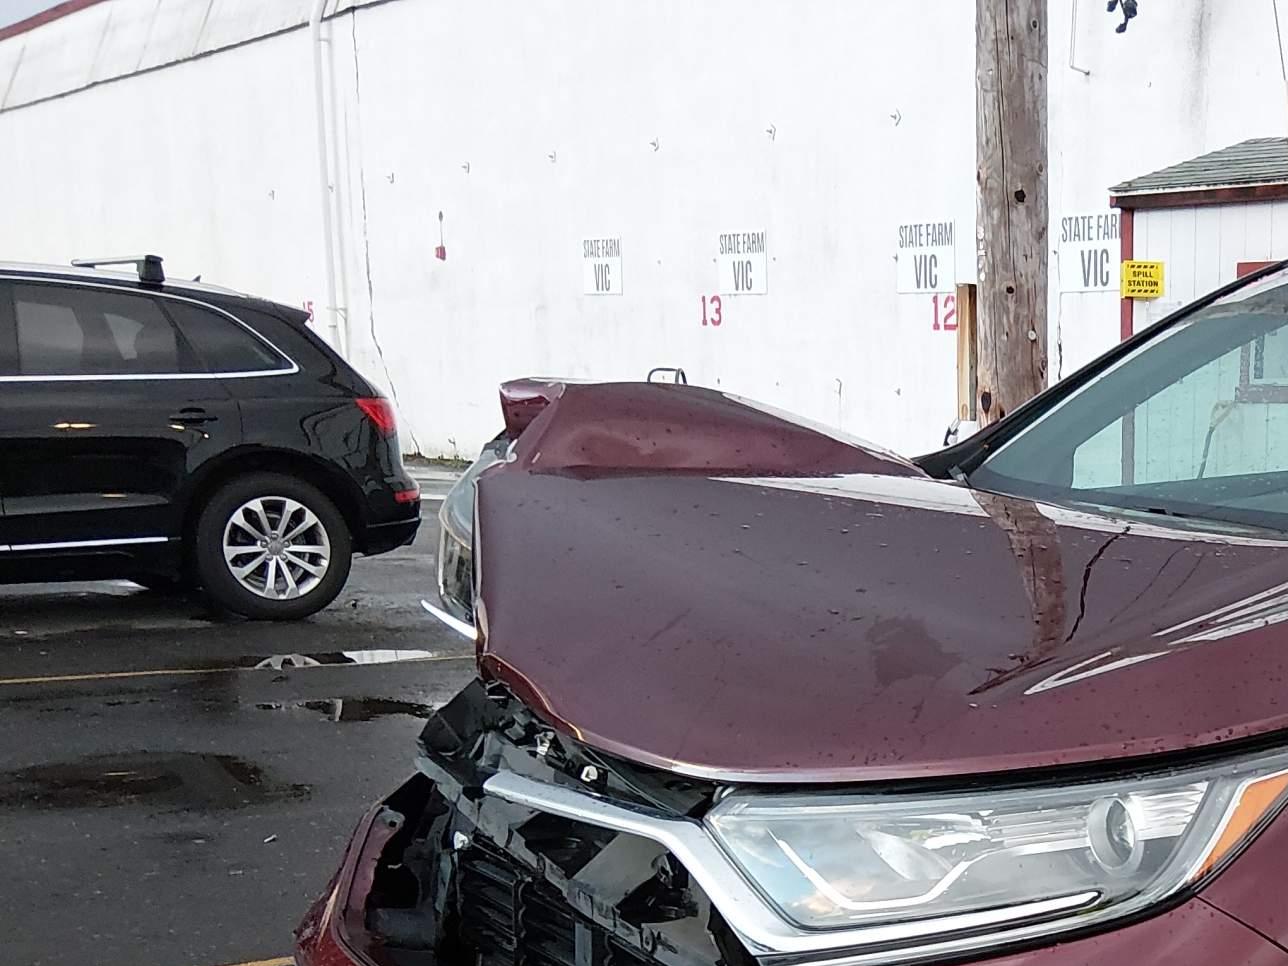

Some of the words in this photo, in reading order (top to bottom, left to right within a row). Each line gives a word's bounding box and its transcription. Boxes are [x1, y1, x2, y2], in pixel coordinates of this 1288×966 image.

[898, 223, 924, 249] STATE
[925, 221, 953, 247] FARM
[1061, 215, 1094, 243] STATE
[1096, 213, 1121, 241] FAR
[583, 239, 600, 259] STATE
[601, 238, 620, 258] FARM
[719, 234, 741, 255] STATE
[742, 231, 765, 254] FARM
[593, 263, 611, 292] VIC
[732, 260, 753, 292] VIC
[913, 253, 938, 290] VIC
[1080, 248, 1110, 288] VIC
[1132, 270, 1153, 278] SPILL
[1127, 279, 1159, 287] STATION
[701, 295, 722, 327] 13
[932, 294, 958, 331] 12
